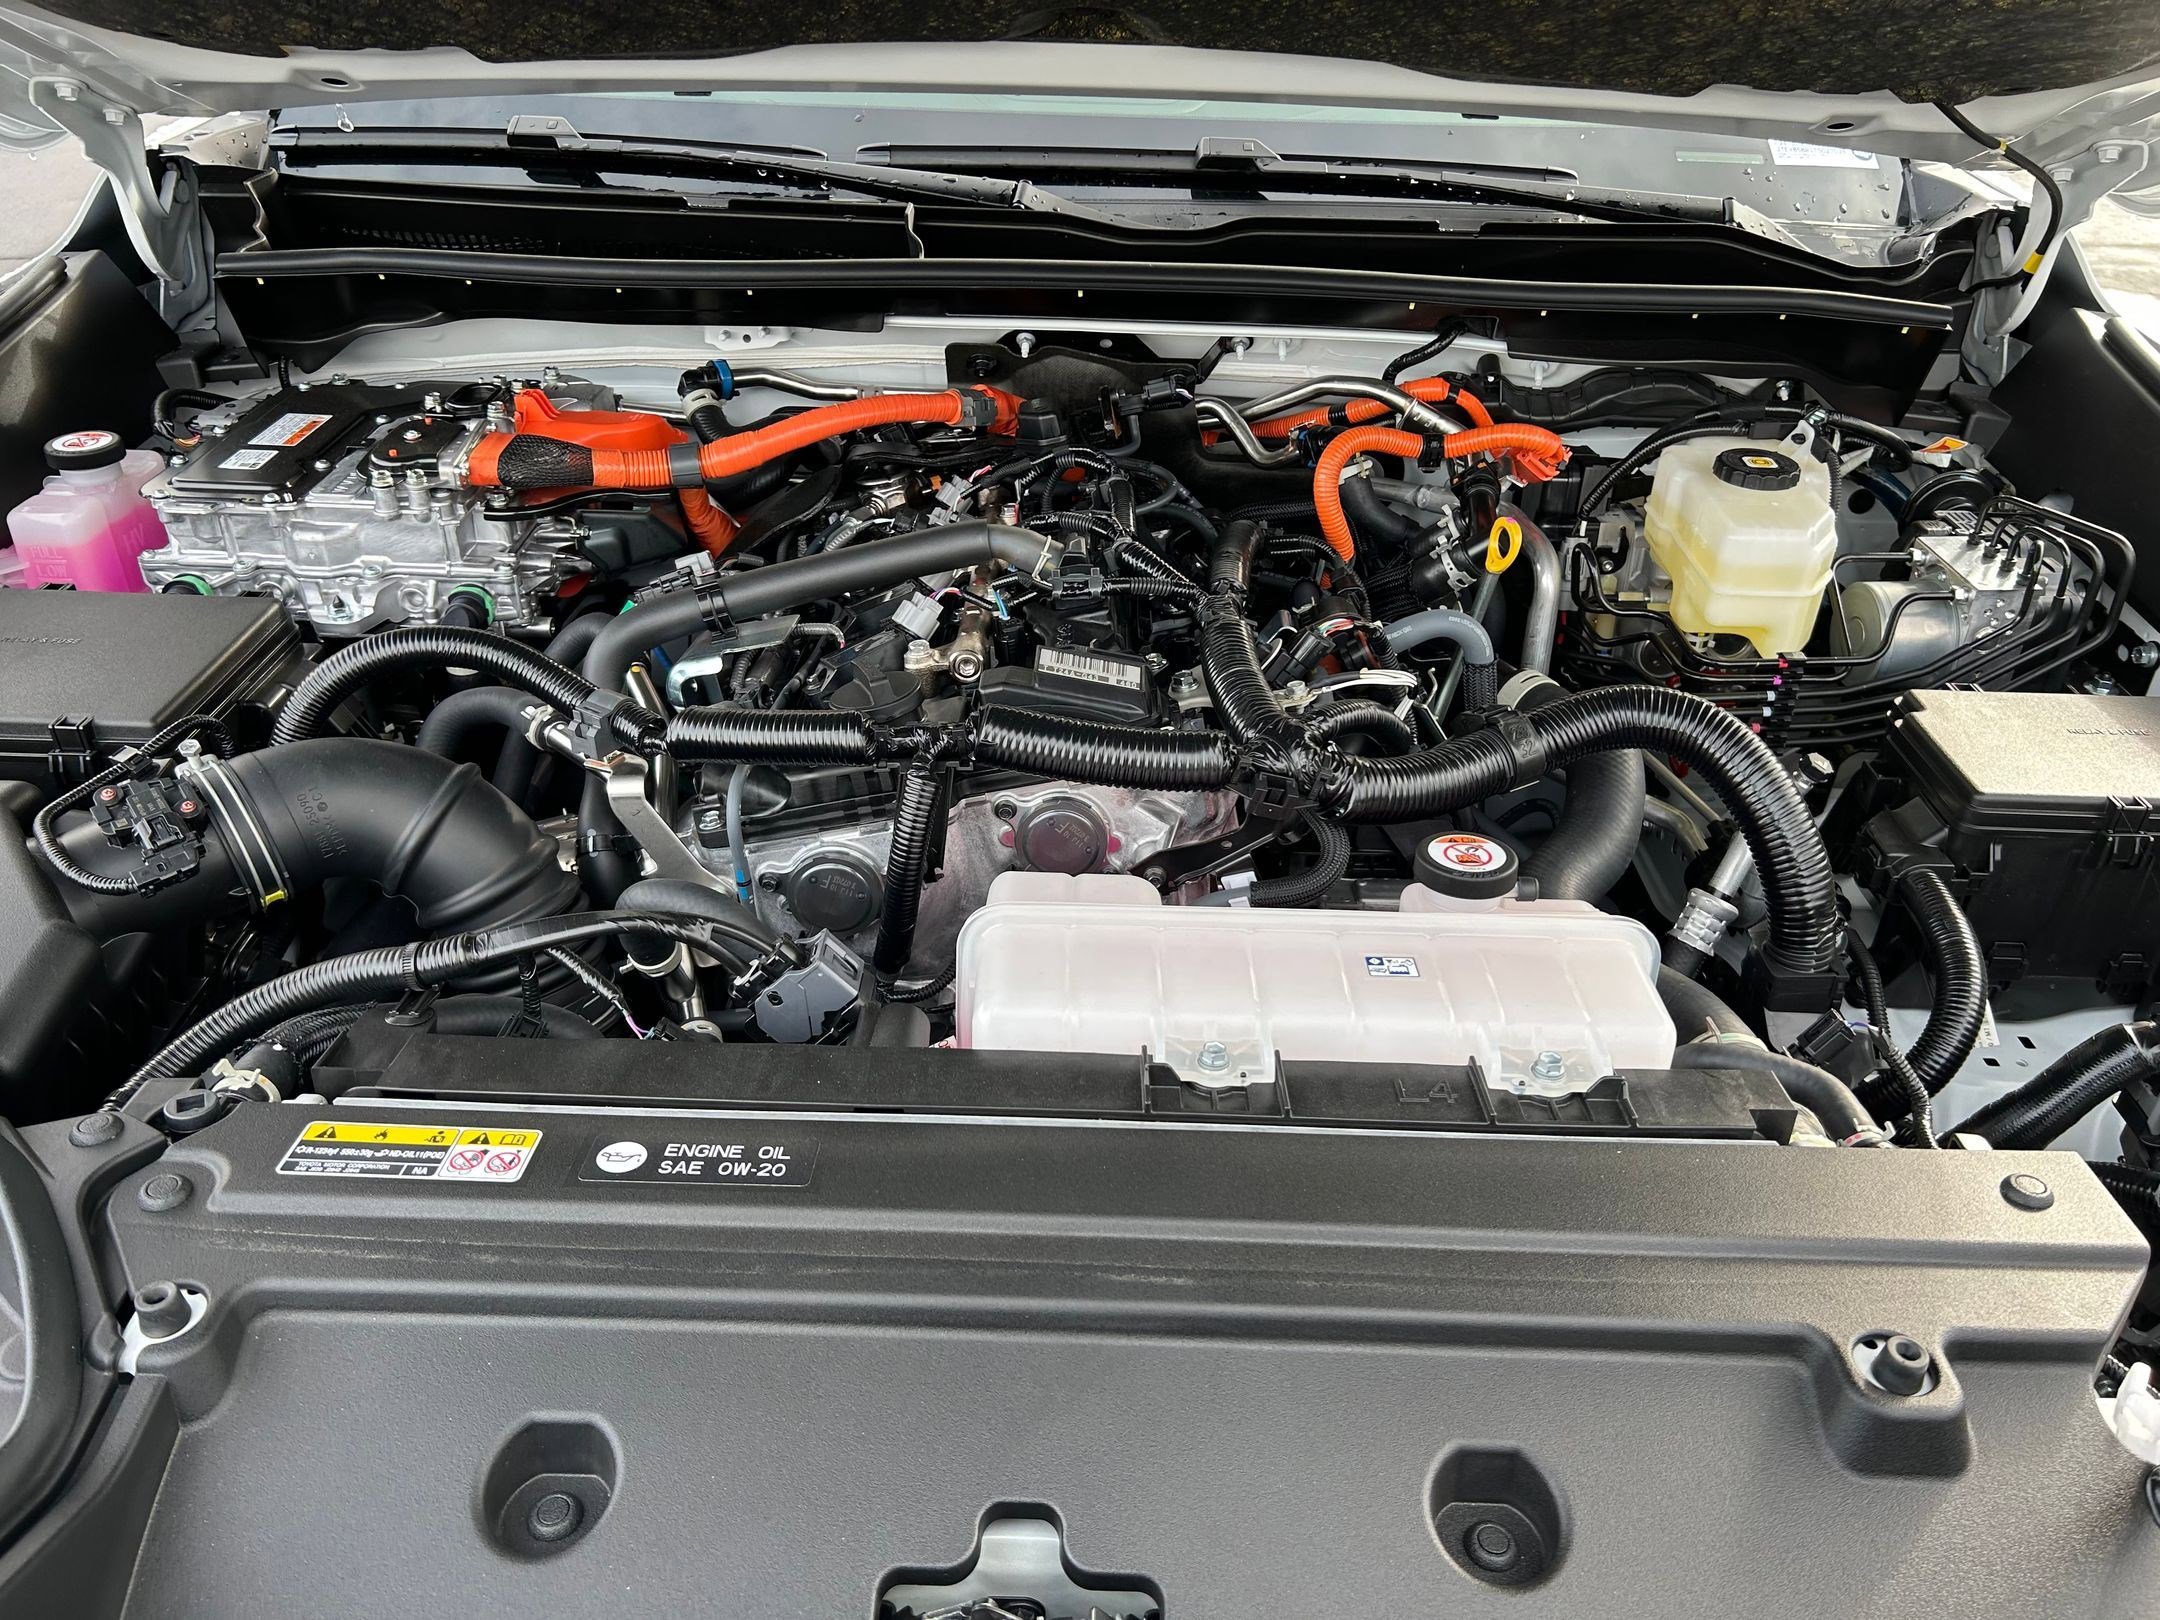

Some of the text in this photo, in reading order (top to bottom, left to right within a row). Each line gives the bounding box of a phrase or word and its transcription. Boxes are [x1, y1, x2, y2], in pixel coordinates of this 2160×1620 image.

[30, 545, 64, 559] FULL
[35, 563, 68, 578] LOW
[819, 874, 832, 889] F
[1393, 1078, 1459, 1104] L4
[663, 1143, 792, 1160] ENGINE OIL
[347, 1163, 391, 1171] CORPORATION
[411, 1166, 428, 1176] NA
[657, 1160, 787, 1178] SAE 0W-20
